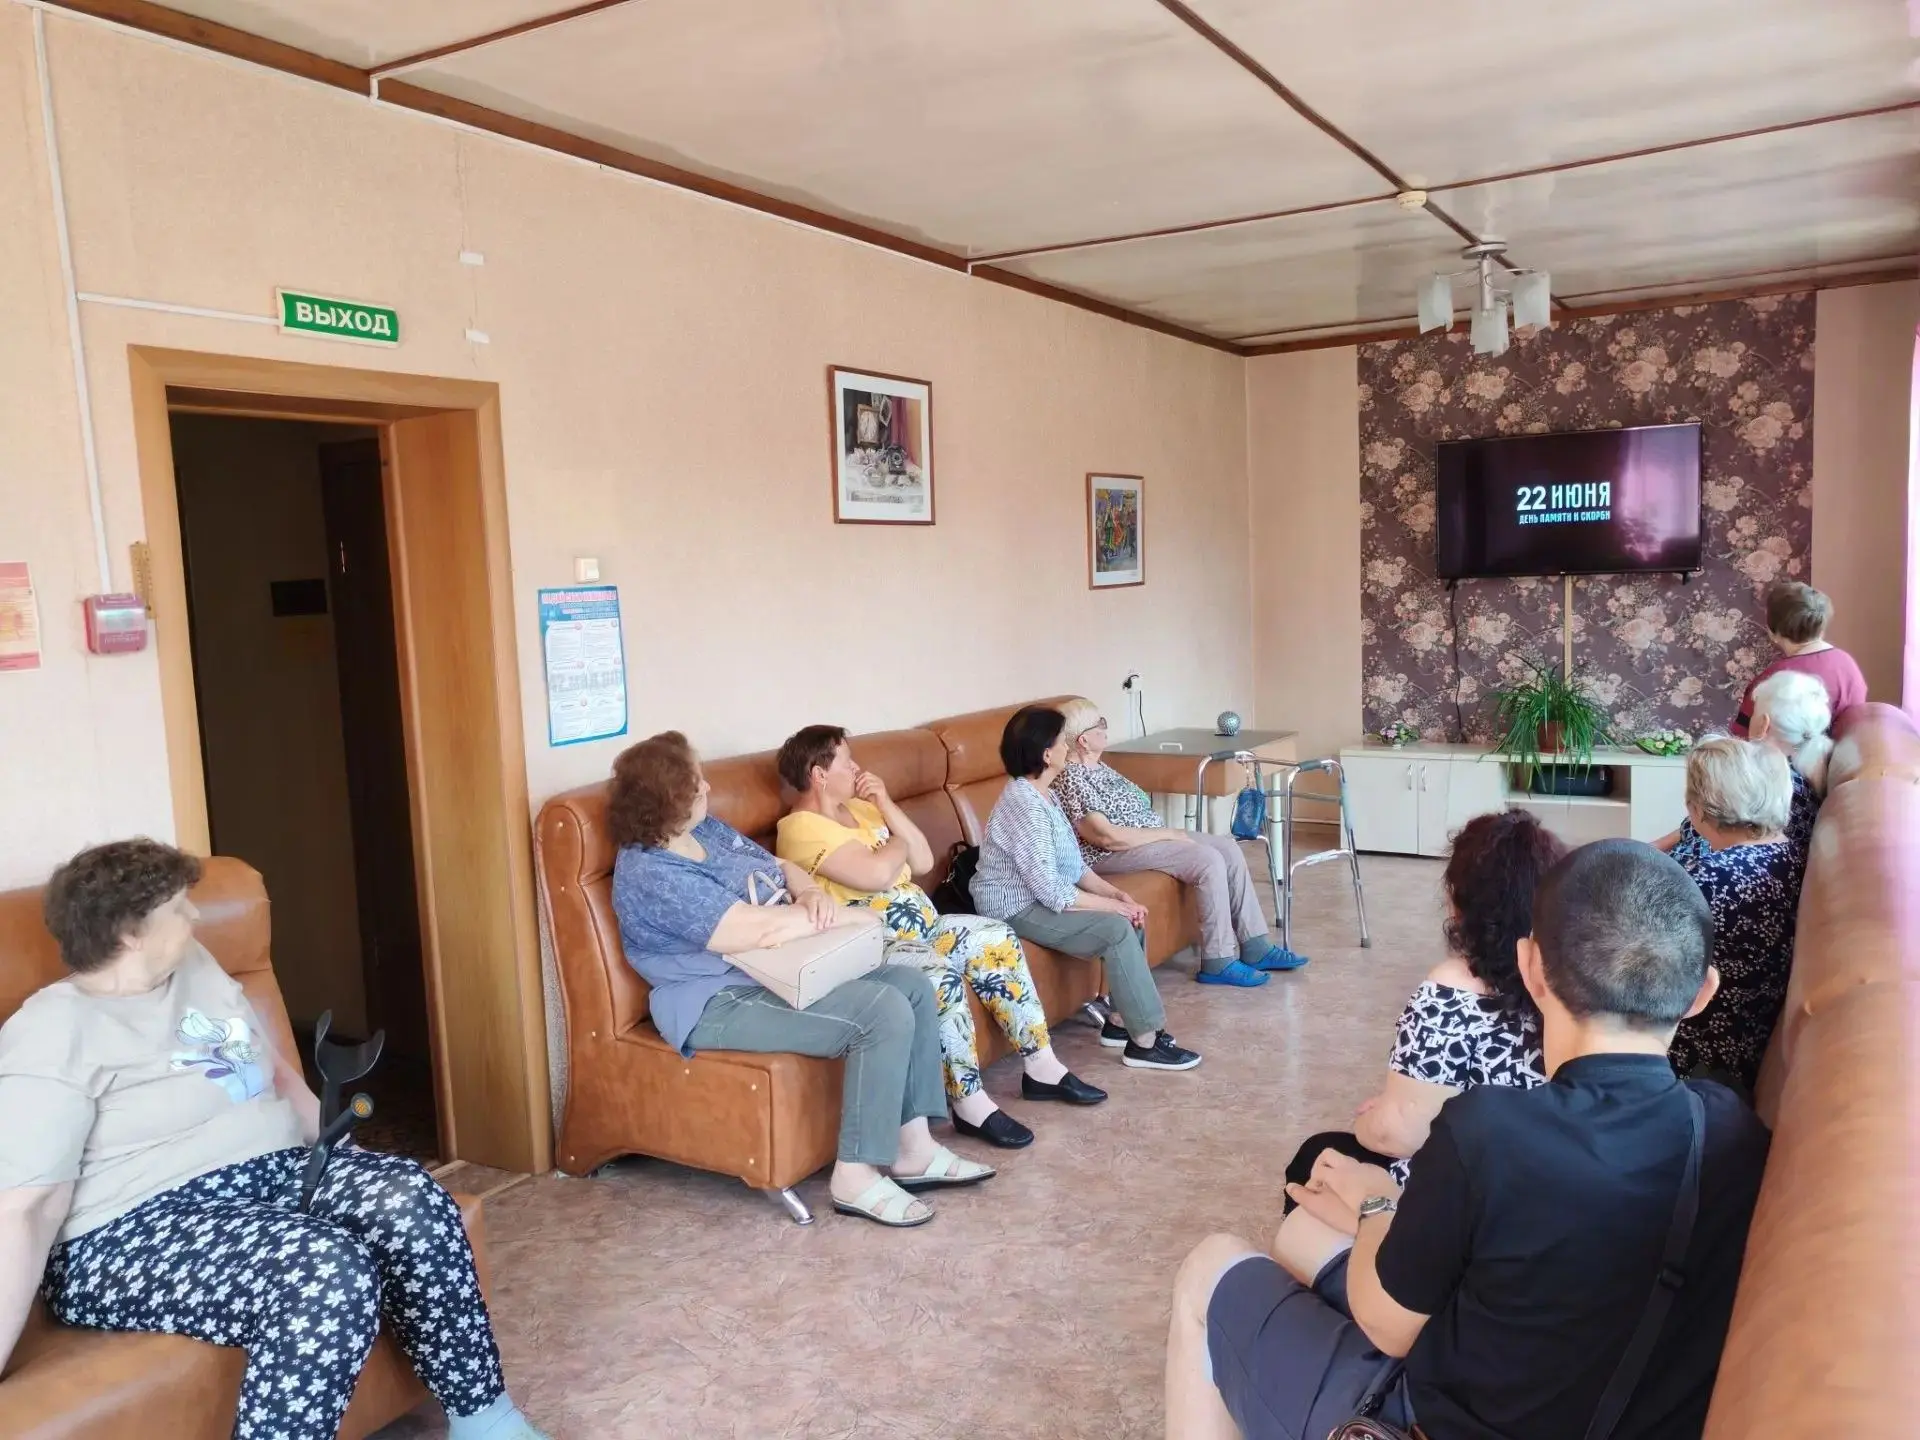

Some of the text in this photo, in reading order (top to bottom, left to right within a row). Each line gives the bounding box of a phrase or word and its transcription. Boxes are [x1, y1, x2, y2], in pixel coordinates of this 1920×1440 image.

[295, 302, 391, 336] ВЫХОД
[1516, 482, 1611, 511] 22 ИЮНЯ
[1519, 510, 1611, 525] ДЕНЬ ПАМЯТИ И СКОРБИ
